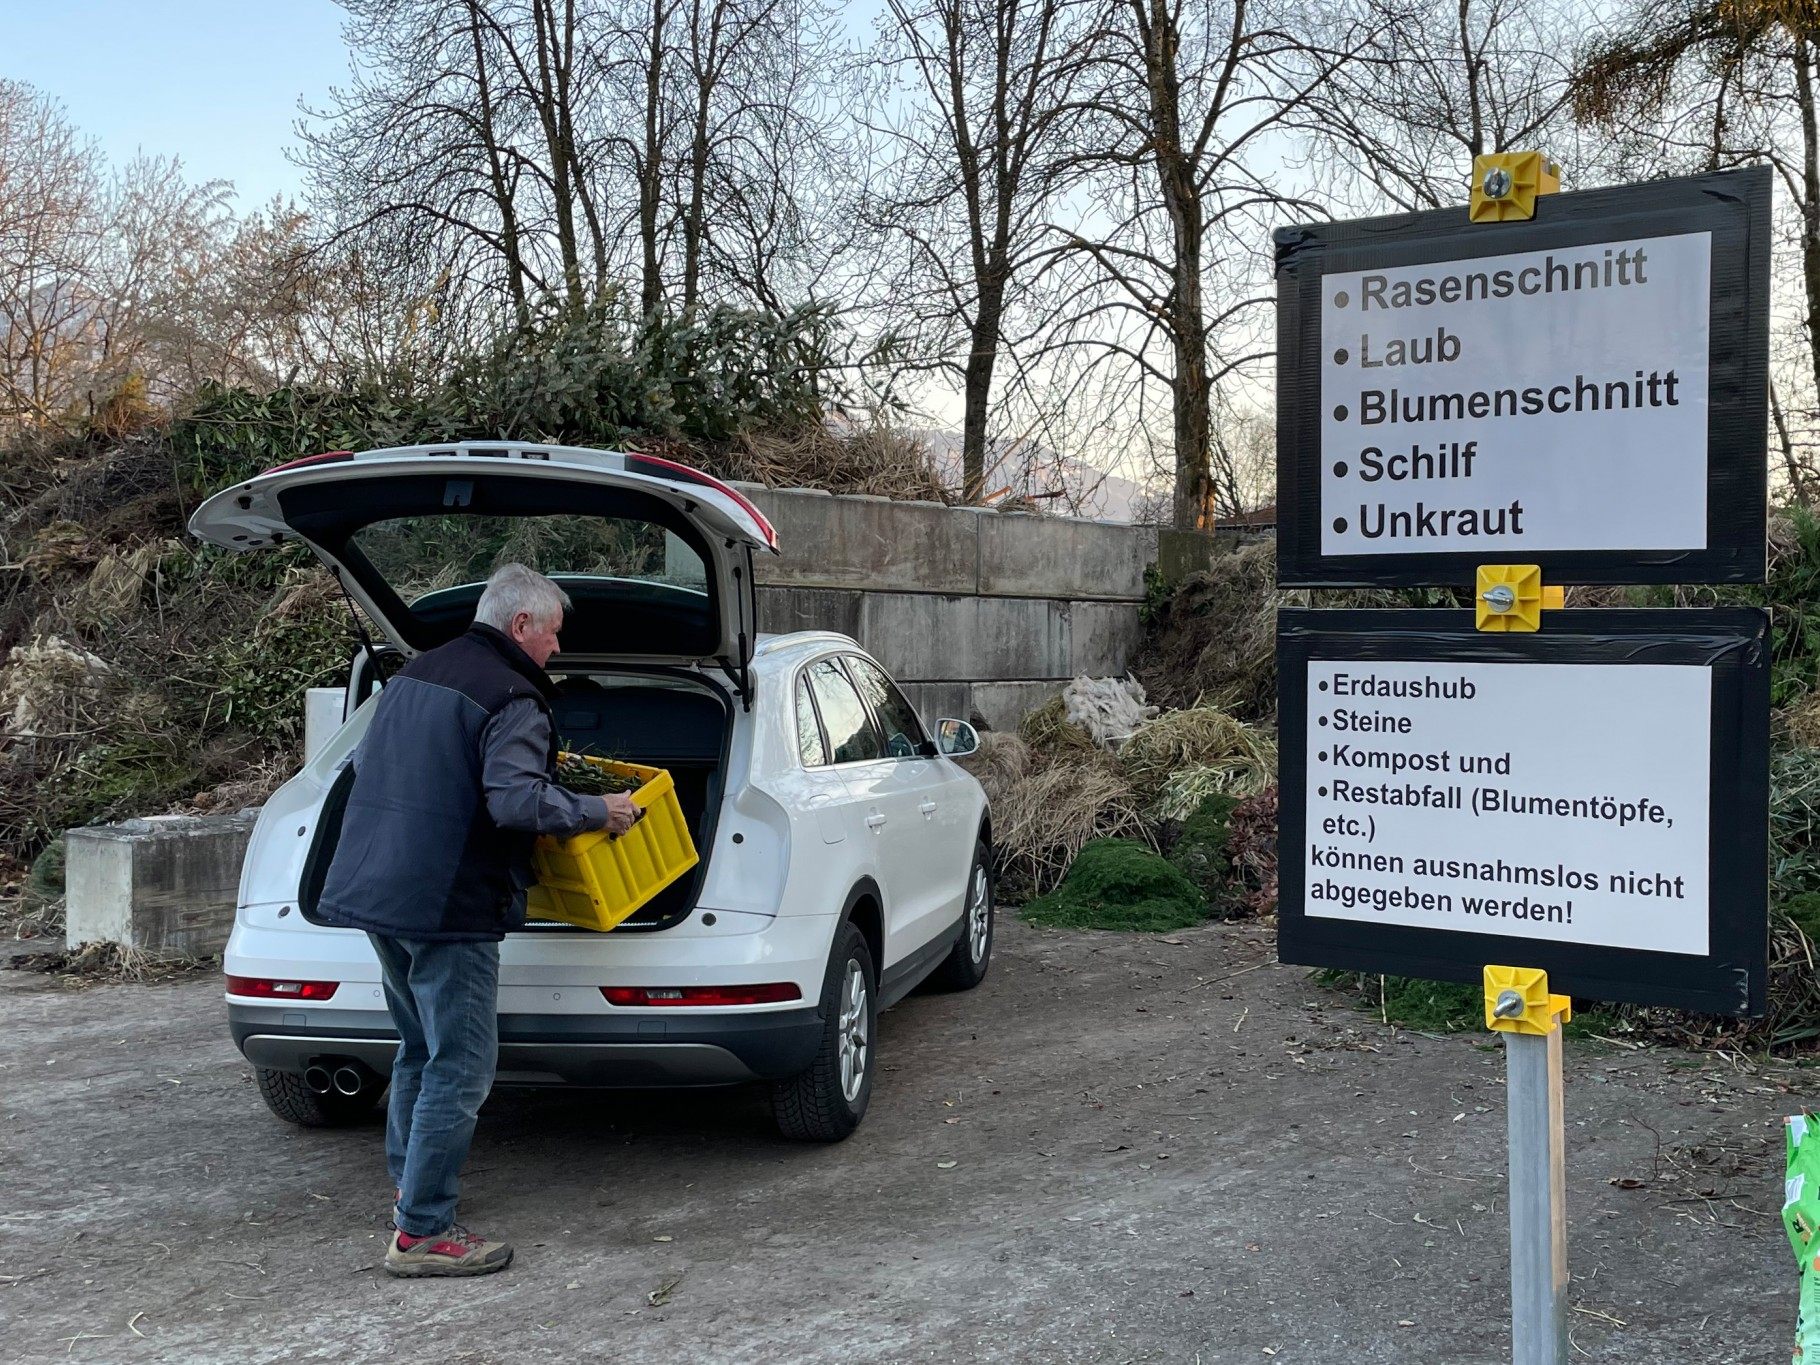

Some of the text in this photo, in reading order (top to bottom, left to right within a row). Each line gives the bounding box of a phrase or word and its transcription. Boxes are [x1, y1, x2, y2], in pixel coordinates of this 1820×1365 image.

[1361, 247, 1648, 312] Rasenschnitt
[1361, 326, 1461, 369] Laub
[1360, 369, 1680, 426] Blumenschnitt
[1358, 440, 1478, 483] Schilf
[1359, 499, 1524, 539] Unkraut
[1333, 673, 1476, 700] Erdaushub
[1332, 708, 1412, 734] Steine
[1333, 743, 1511, 776] Kompost und
[1332, 779, 1673, 829] Restabfall (Blumentöpfe,
[1322, 813, 1376, 844] etc.)
[1311, 844, 1685, 899] können ausnahmslos nicht
[1310, 878, 1572, 924] abgegeben werden!
